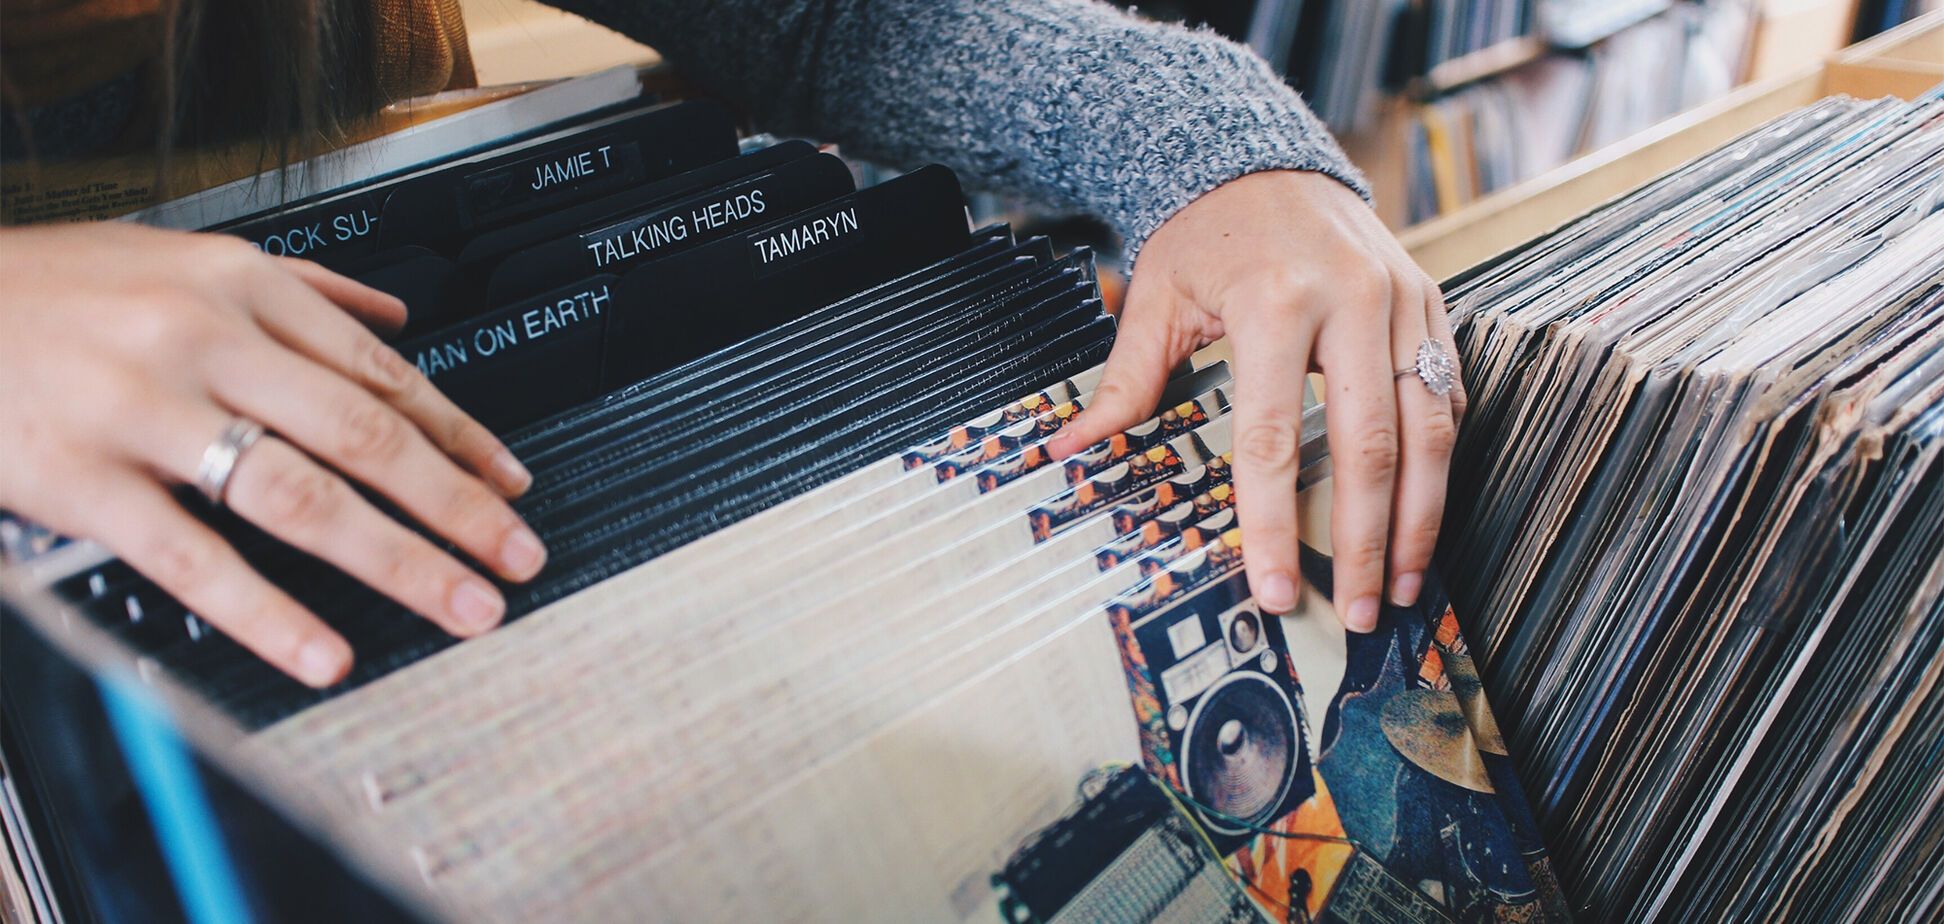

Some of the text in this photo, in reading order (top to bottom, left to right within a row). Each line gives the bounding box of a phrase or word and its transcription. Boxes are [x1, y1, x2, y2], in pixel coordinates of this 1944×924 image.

[531, 145, 612, 190] JAMIE T
[333, 209, 378, 241] SU-
[587, 189, 766, 267] TALKING HEADS
[754, 208, 858, 264] TAMARYN
[474, 319, 518, 356] ON
[522, 285, 610, 339] EARTH
